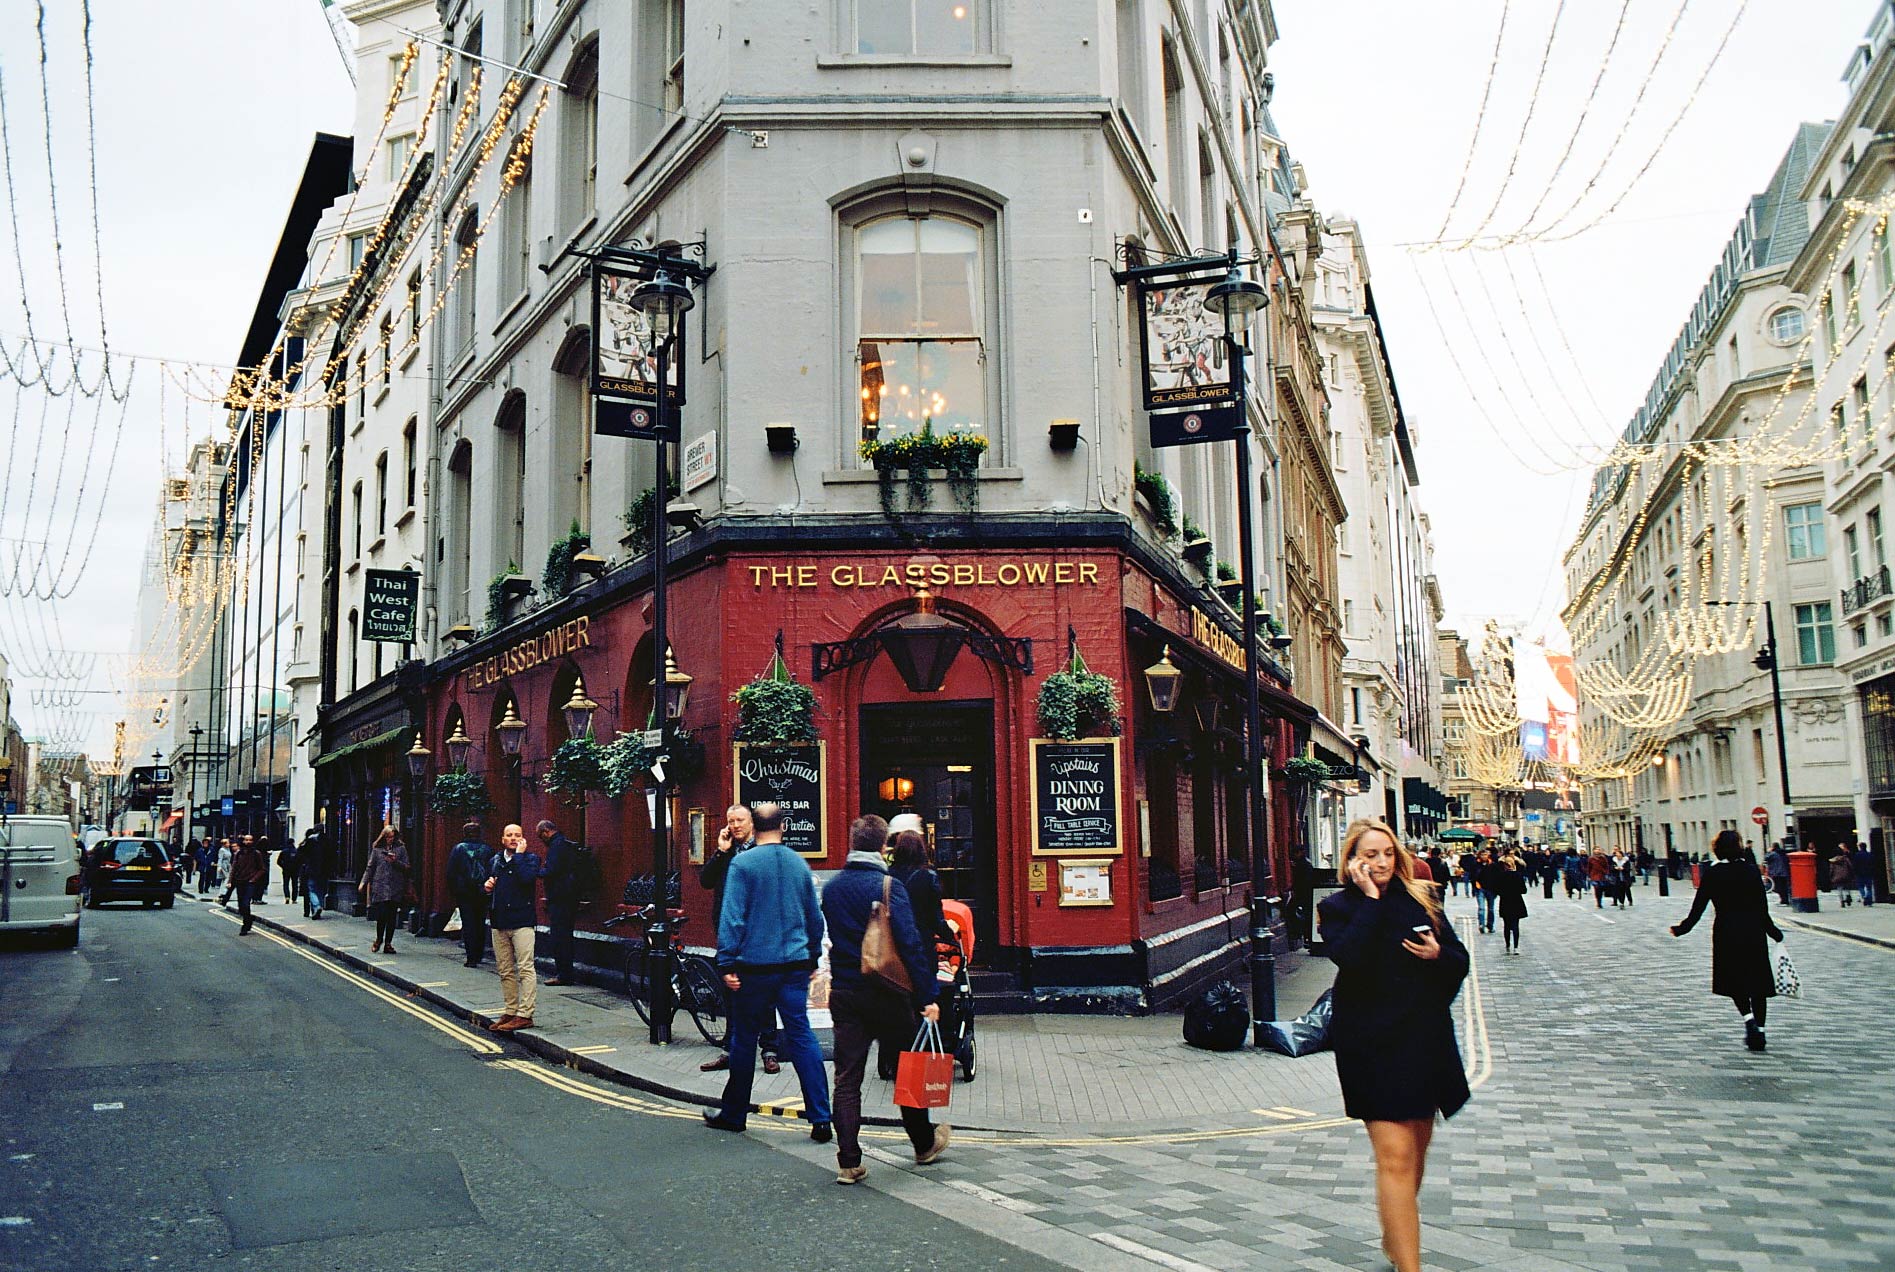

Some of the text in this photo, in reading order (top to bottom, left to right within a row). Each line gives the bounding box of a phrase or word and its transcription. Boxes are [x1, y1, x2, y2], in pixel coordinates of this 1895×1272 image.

[600, 381, 676, 398] GLASSBLOR
[1152, 388, 1230, 403] GLASSBLOWER
[687, 441, 706, 462] BREWER
[687, 456, 703, 476] STREET
[749, 563, 1098, 587] THE GLASSBLOWER
[373, 578, 407, 590] Thai
[369, 593, 409, 606] West
[370, 609, 406, 621] Cafe
[1191, 604, 1211, 648] THE
[461, 615, 590, 689] THE GLASSBLOWER
[740, 757, 819, 783] Christmas
[1050, 757, 1100, 778] Upstairs
[1050, 780, 1104, 794] DINING
[793, 800, 810, 809] BAR
[1056, 796, 1100, 815] ROOM
[781, 816, 816, 832] Parties
[1053, 819, 1100, 830] FULL TABLE SERVICE
